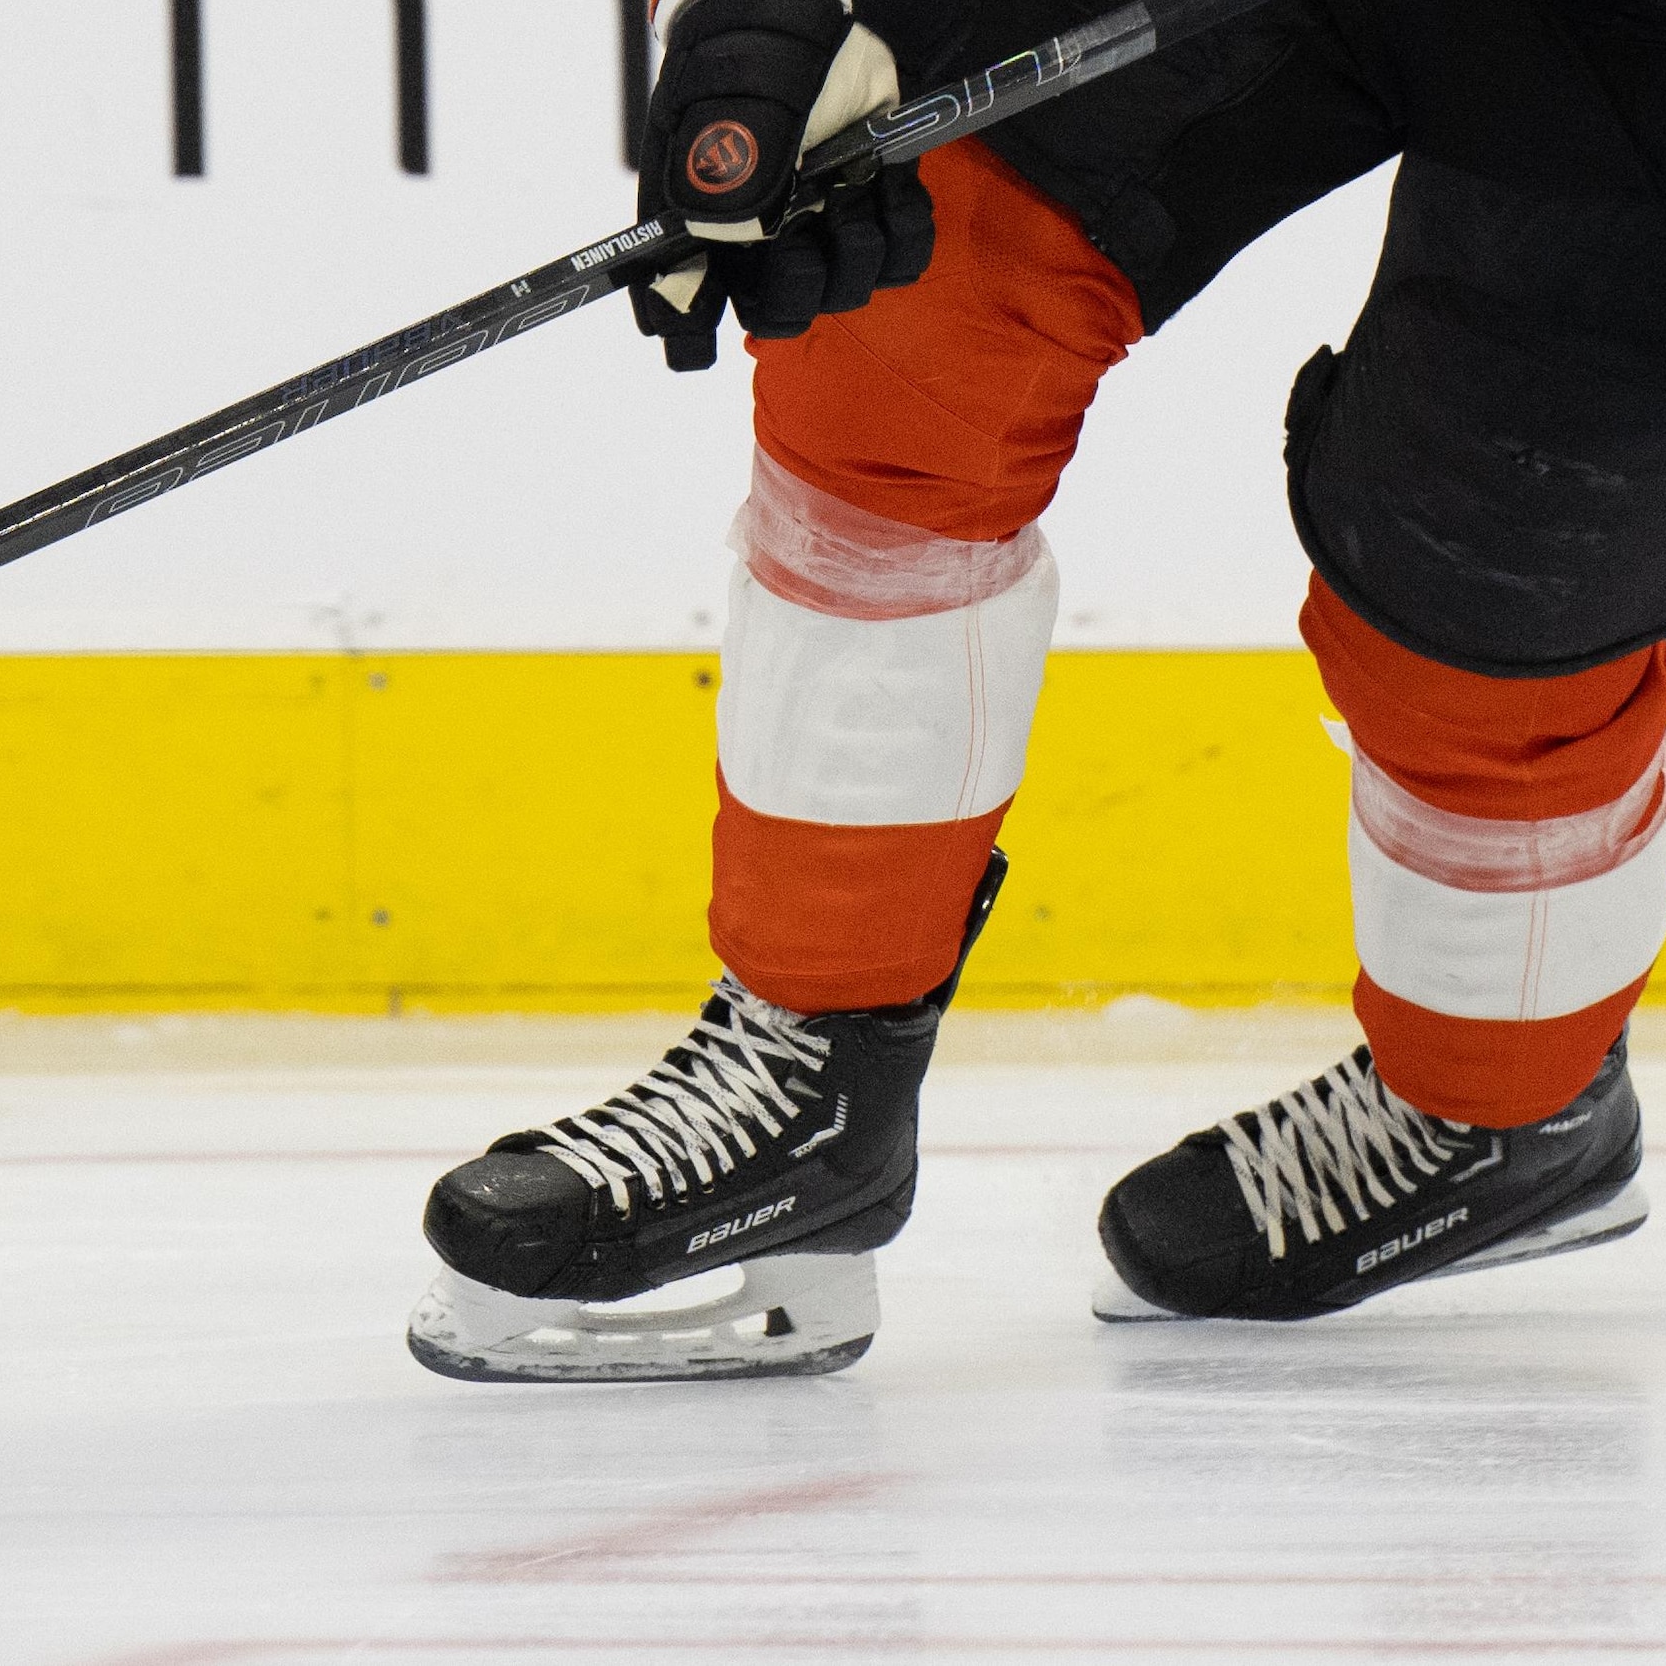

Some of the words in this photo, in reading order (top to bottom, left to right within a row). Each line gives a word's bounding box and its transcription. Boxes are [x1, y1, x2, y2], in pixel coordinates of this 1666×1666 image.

[570, 219, 664, 272] RISTOLAINEN
[686, 1195, 796, 1254] BAUER
[1356, 1207, 1468, 1275] BAUER
